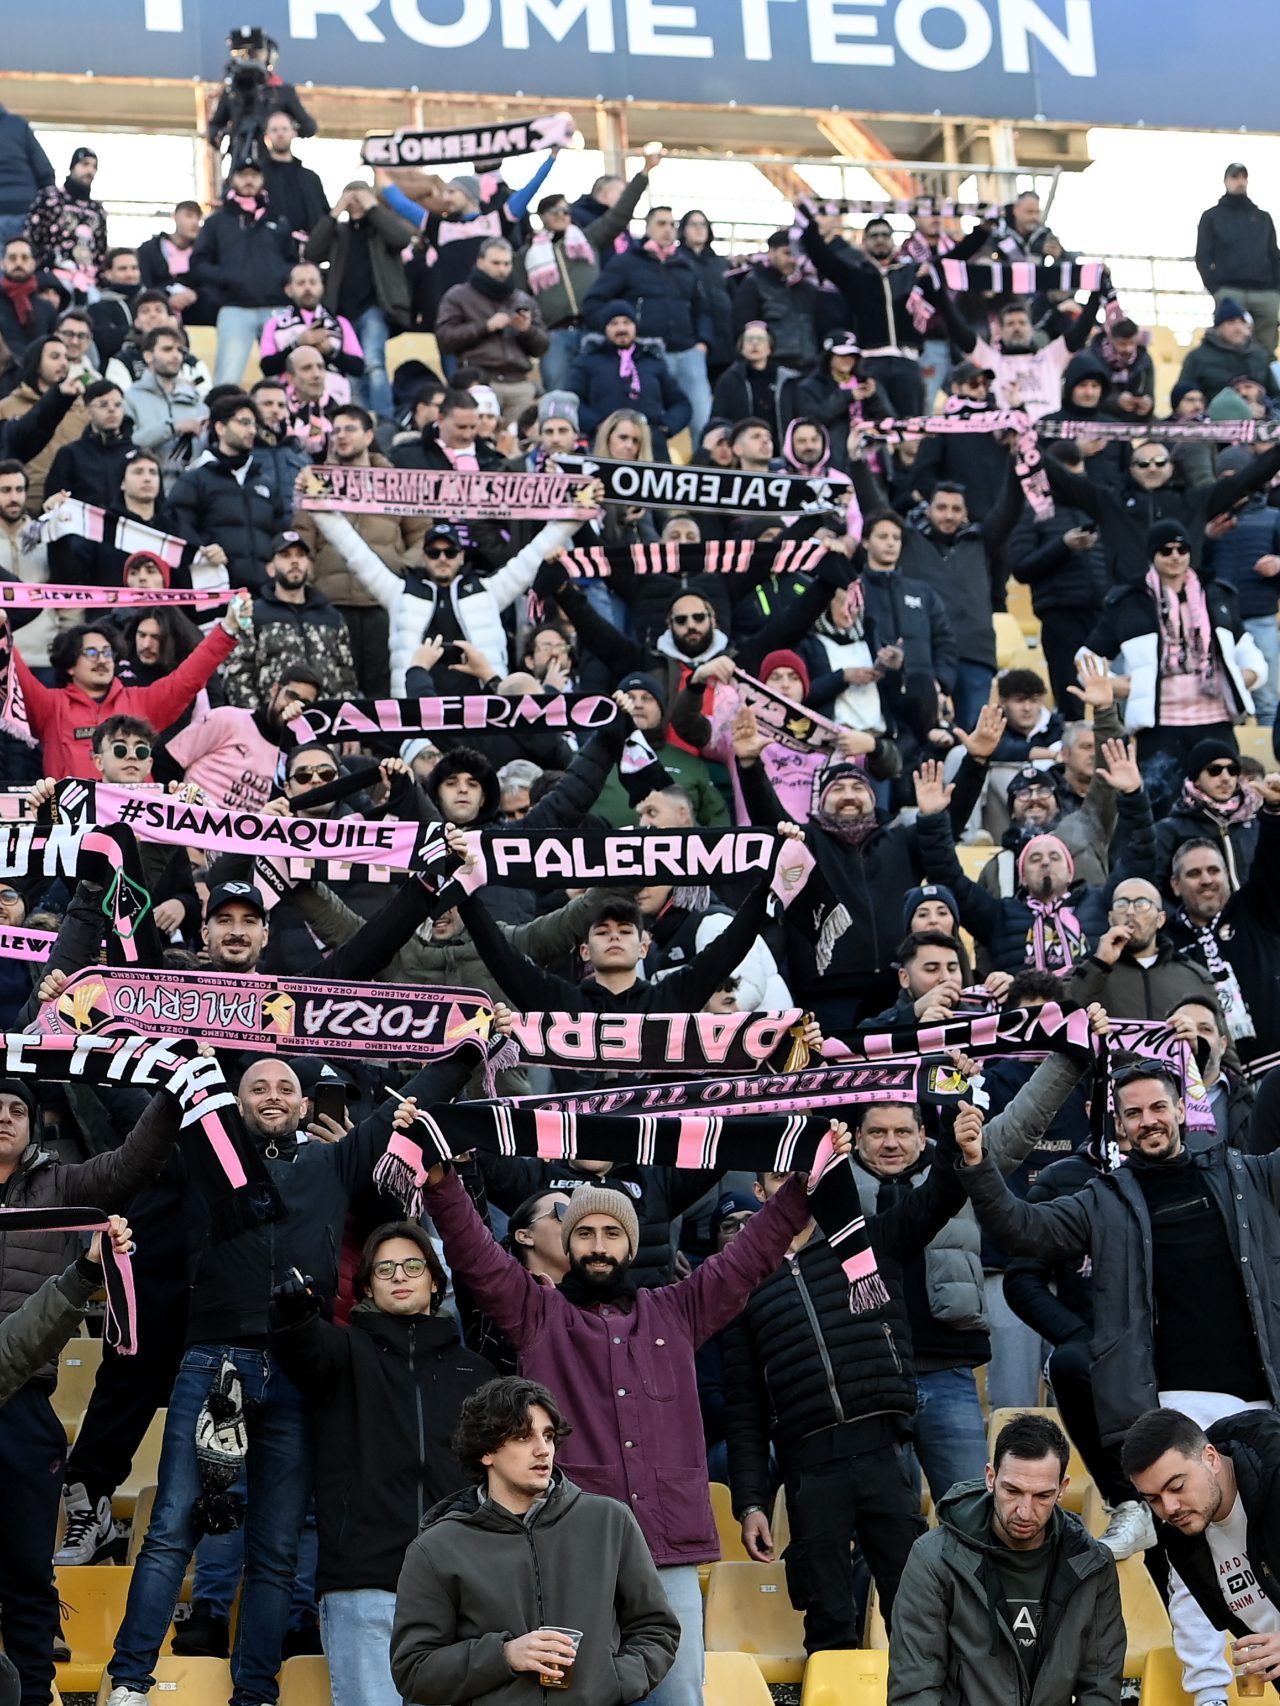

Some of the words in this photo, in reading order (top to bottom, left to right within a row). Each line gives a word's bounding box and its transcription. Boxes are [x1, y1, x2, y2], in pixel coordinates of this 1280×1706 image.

[144, 0, 1097, 78] ROMETEON
[288, 693, 619, 744] PALERMO
[118, 799, 396, 852] #SIAMOAQUILE
[491, 832, 775, 878] PALERMO
[110, 971, 150, 981] PALERMO
[153, 973, 185, 983] FORZA
[196, 977, 238, 986] PALERMO
[240, 979, 272, 989] FORZA
[283, 983, 323, 993] PALERMO
[326, 986, 358, 995] FORZA
[370, 989, 411, 999] PALERMO
[413, 992, 445, 1001] FORZA
[115, 985, 257, 1028] PALERMO
[122, 1016, 160, 1031] PALERMO
[303, 999, 441, 1039] FORZA
[160, 1025, 190, 1035] FORZA
[200, 1028, 239, 1039] PALERMO
[242, 1032, 272, 1042] FORZA
[282, 1036, 320, 1046] PALERMO
[511, 1008, 803, 1065] PALERM
[323, 1038, 353, 1048] FORZA
[364, 1042, 403, 1051] PALERMO
[405, 1043, 435, 1052] FORZA
[702, 1066, 911, 1101] PALERMO
[641, 1085, 687, 1106] TI
